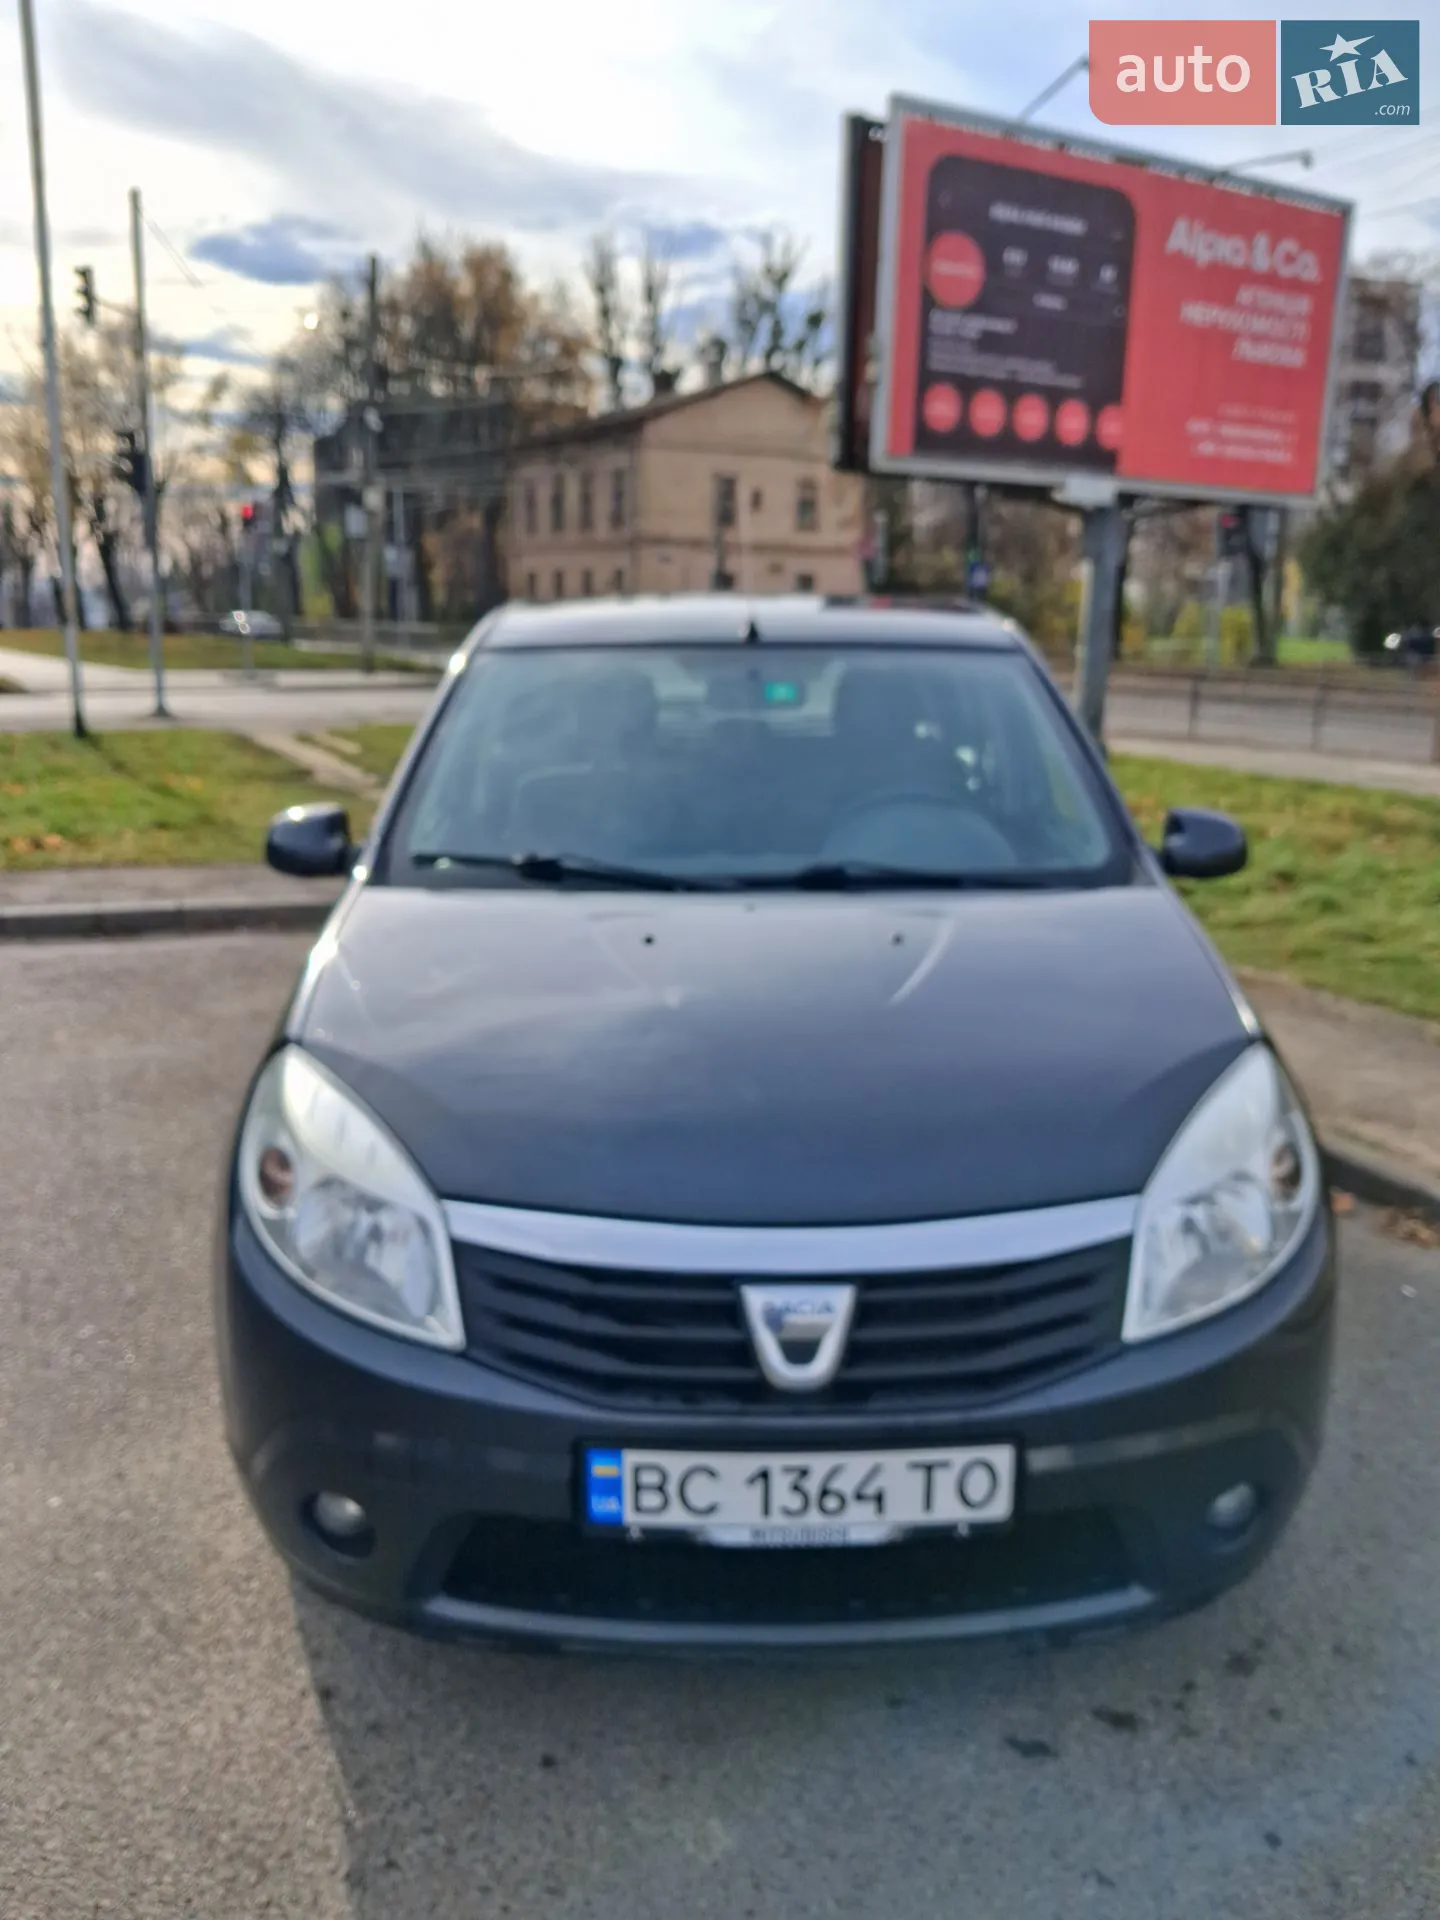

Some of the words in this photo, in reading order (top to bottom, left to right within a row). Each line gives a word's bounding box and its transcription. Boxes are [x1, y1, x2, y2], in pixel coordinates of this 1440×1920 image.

[633, 1463, 719, 1517] BC
[747, 1462, 885, 1518] 1364
[906, 1457, 998, 1513] TO
